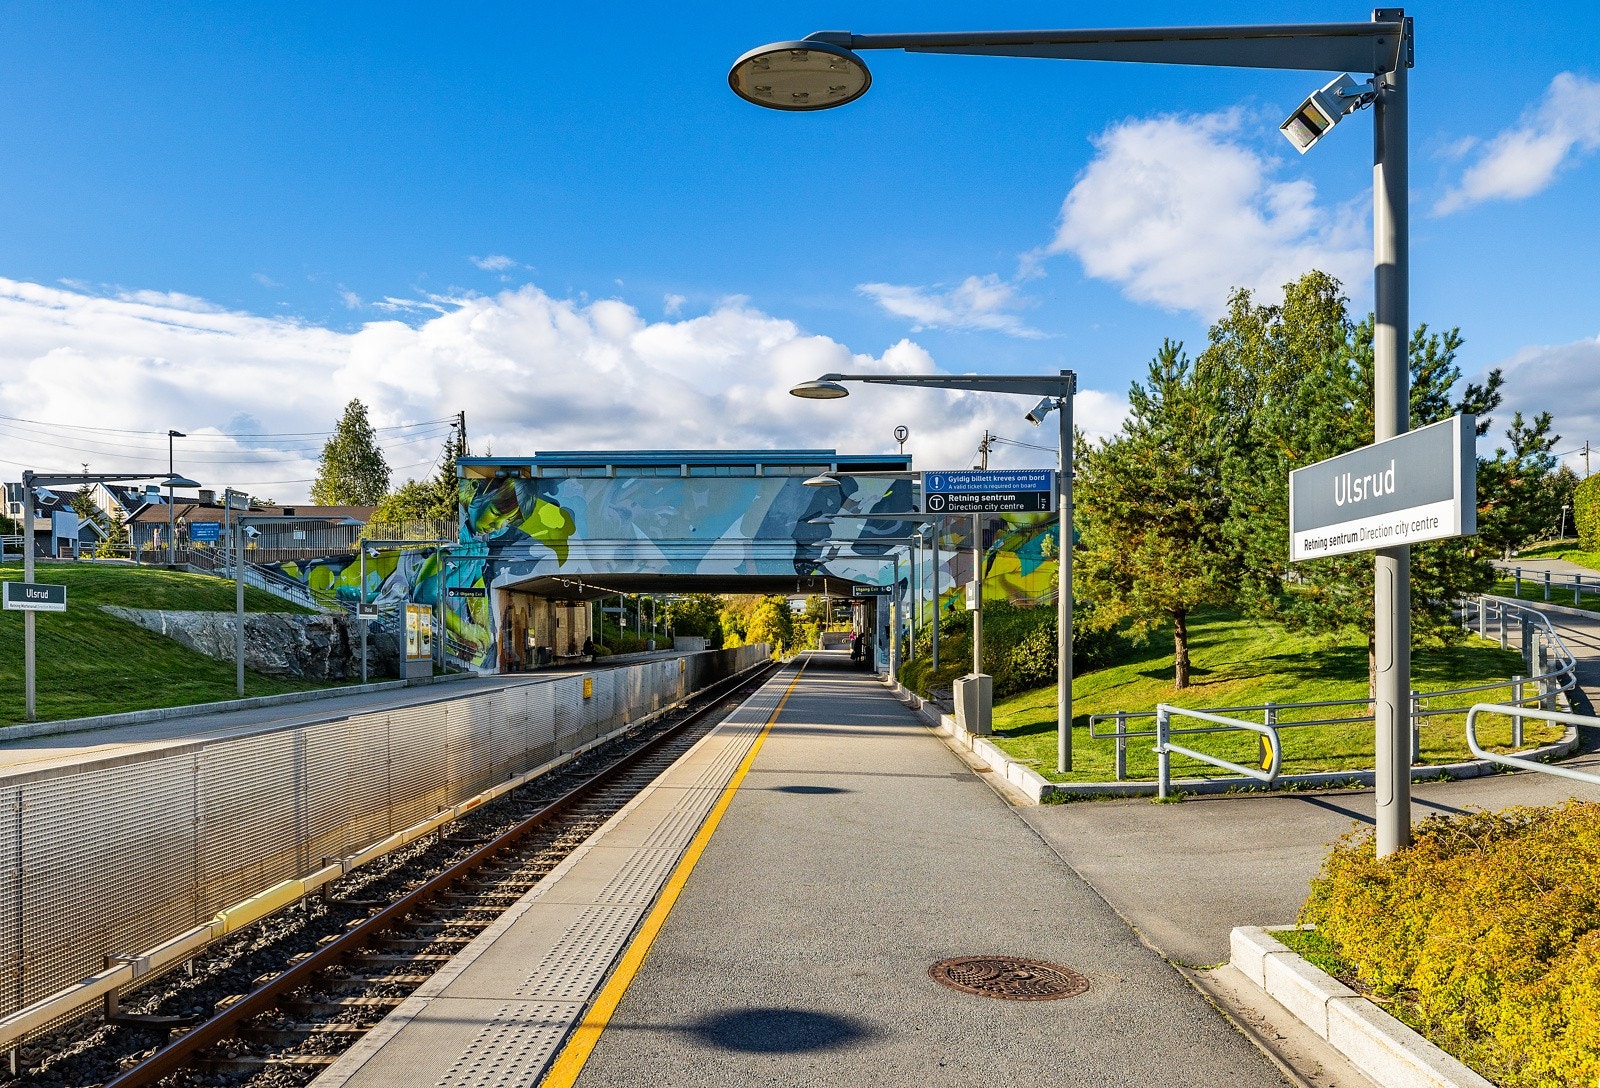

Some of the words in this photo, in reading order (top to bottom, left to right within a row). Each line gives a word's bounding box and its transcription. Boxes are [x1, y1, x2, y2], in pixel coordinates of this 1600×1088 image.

[948, 475, 970, 483] Gyldig
[971, 474, 992, 482] billett
[1334, 459, 1395, 507] Ulsrud
[948, 494, 982, 503] Retning
[948, 503, 982, 511] Direction
[984, 503, 998, 511] city
[1000, 502, 1025, 510] centre
[1304, 536, 1328, 551] Retning
[1328, 532, 1358, 546] sentrum
[1359, 524, 1393, 542] Direction
[1394, 520, 1409, 537] city
[1411, 516, 1439, 532] centre
[26, 588, 49, 599] Ulsrud
